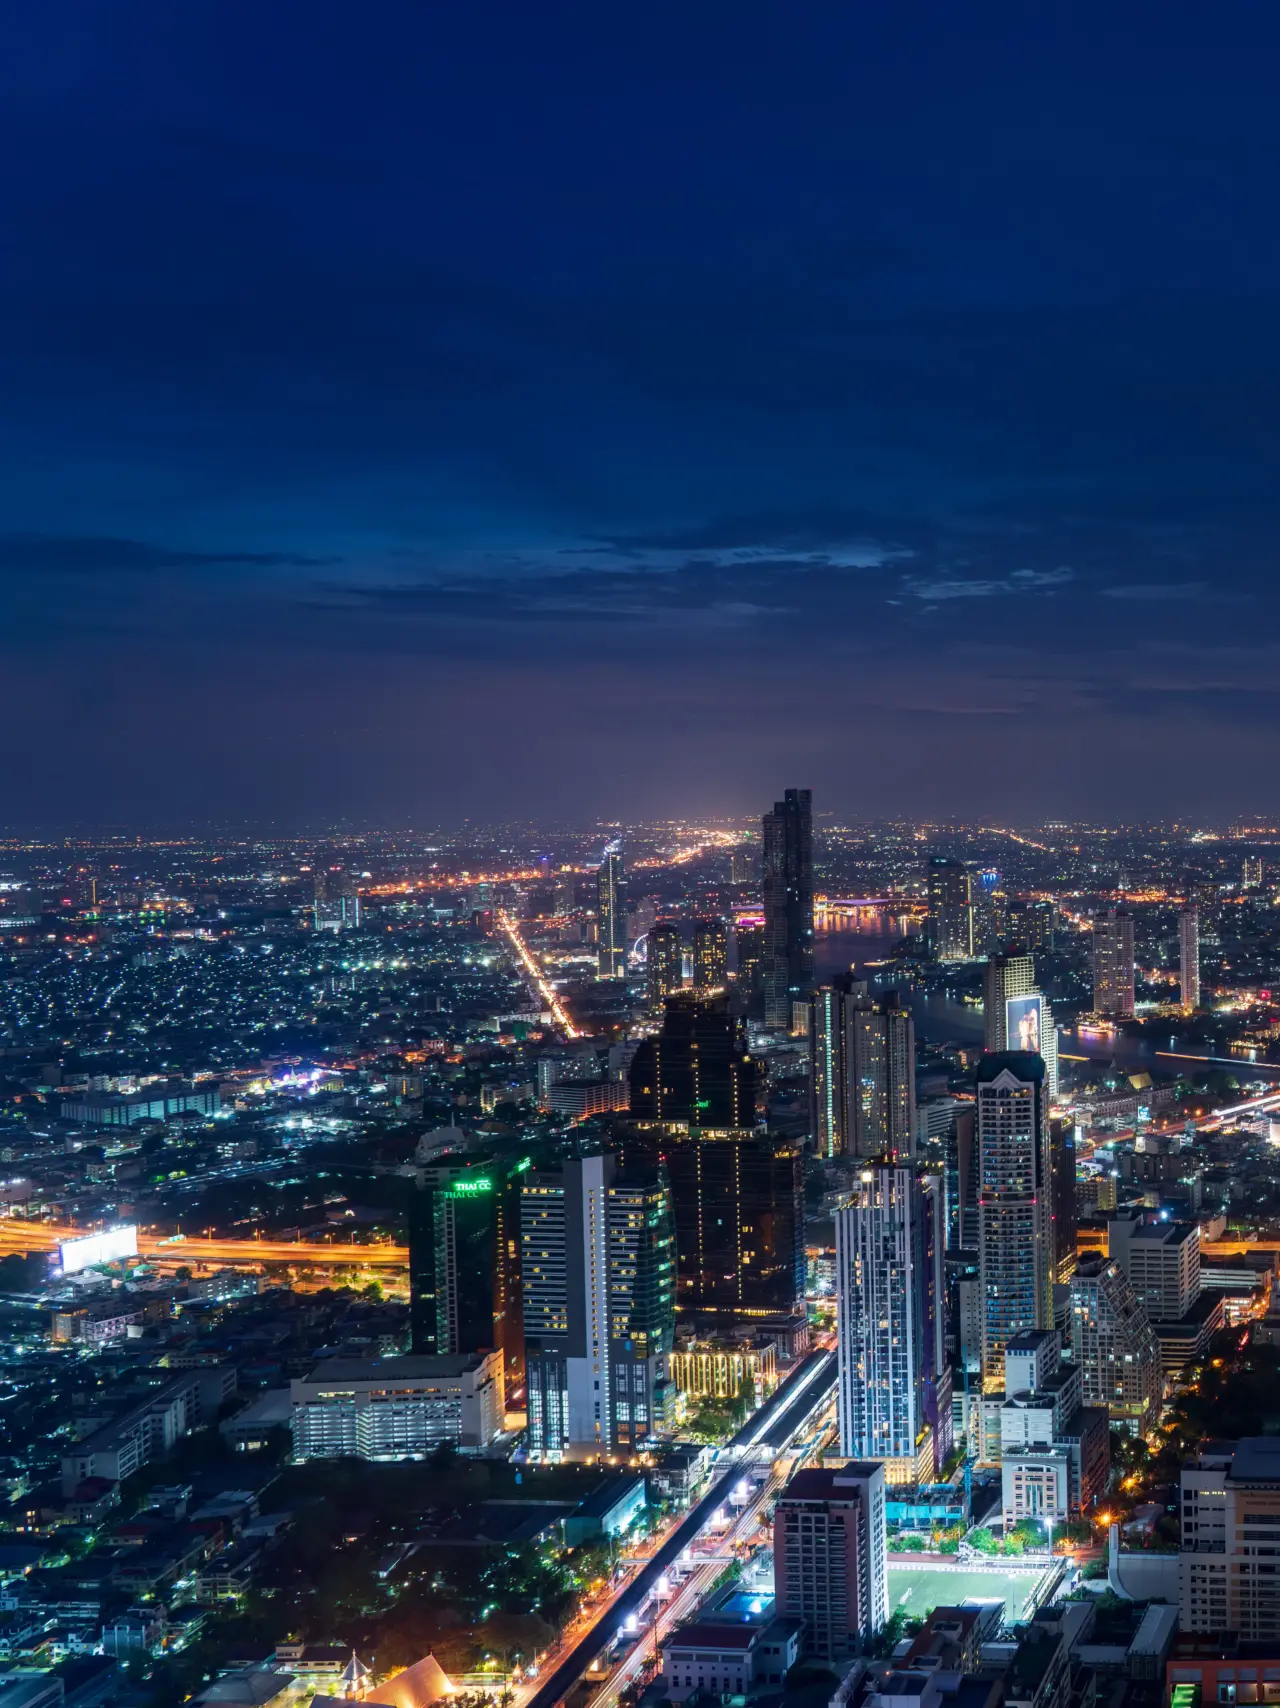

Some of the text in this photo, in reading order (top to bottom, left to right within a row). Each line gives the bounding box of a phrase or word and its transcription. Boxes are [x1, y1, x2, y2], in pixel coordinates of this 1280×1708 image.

[456, 1182, 491, 1191] THAI CC
[444, 1191, 465, 1199] THAI
